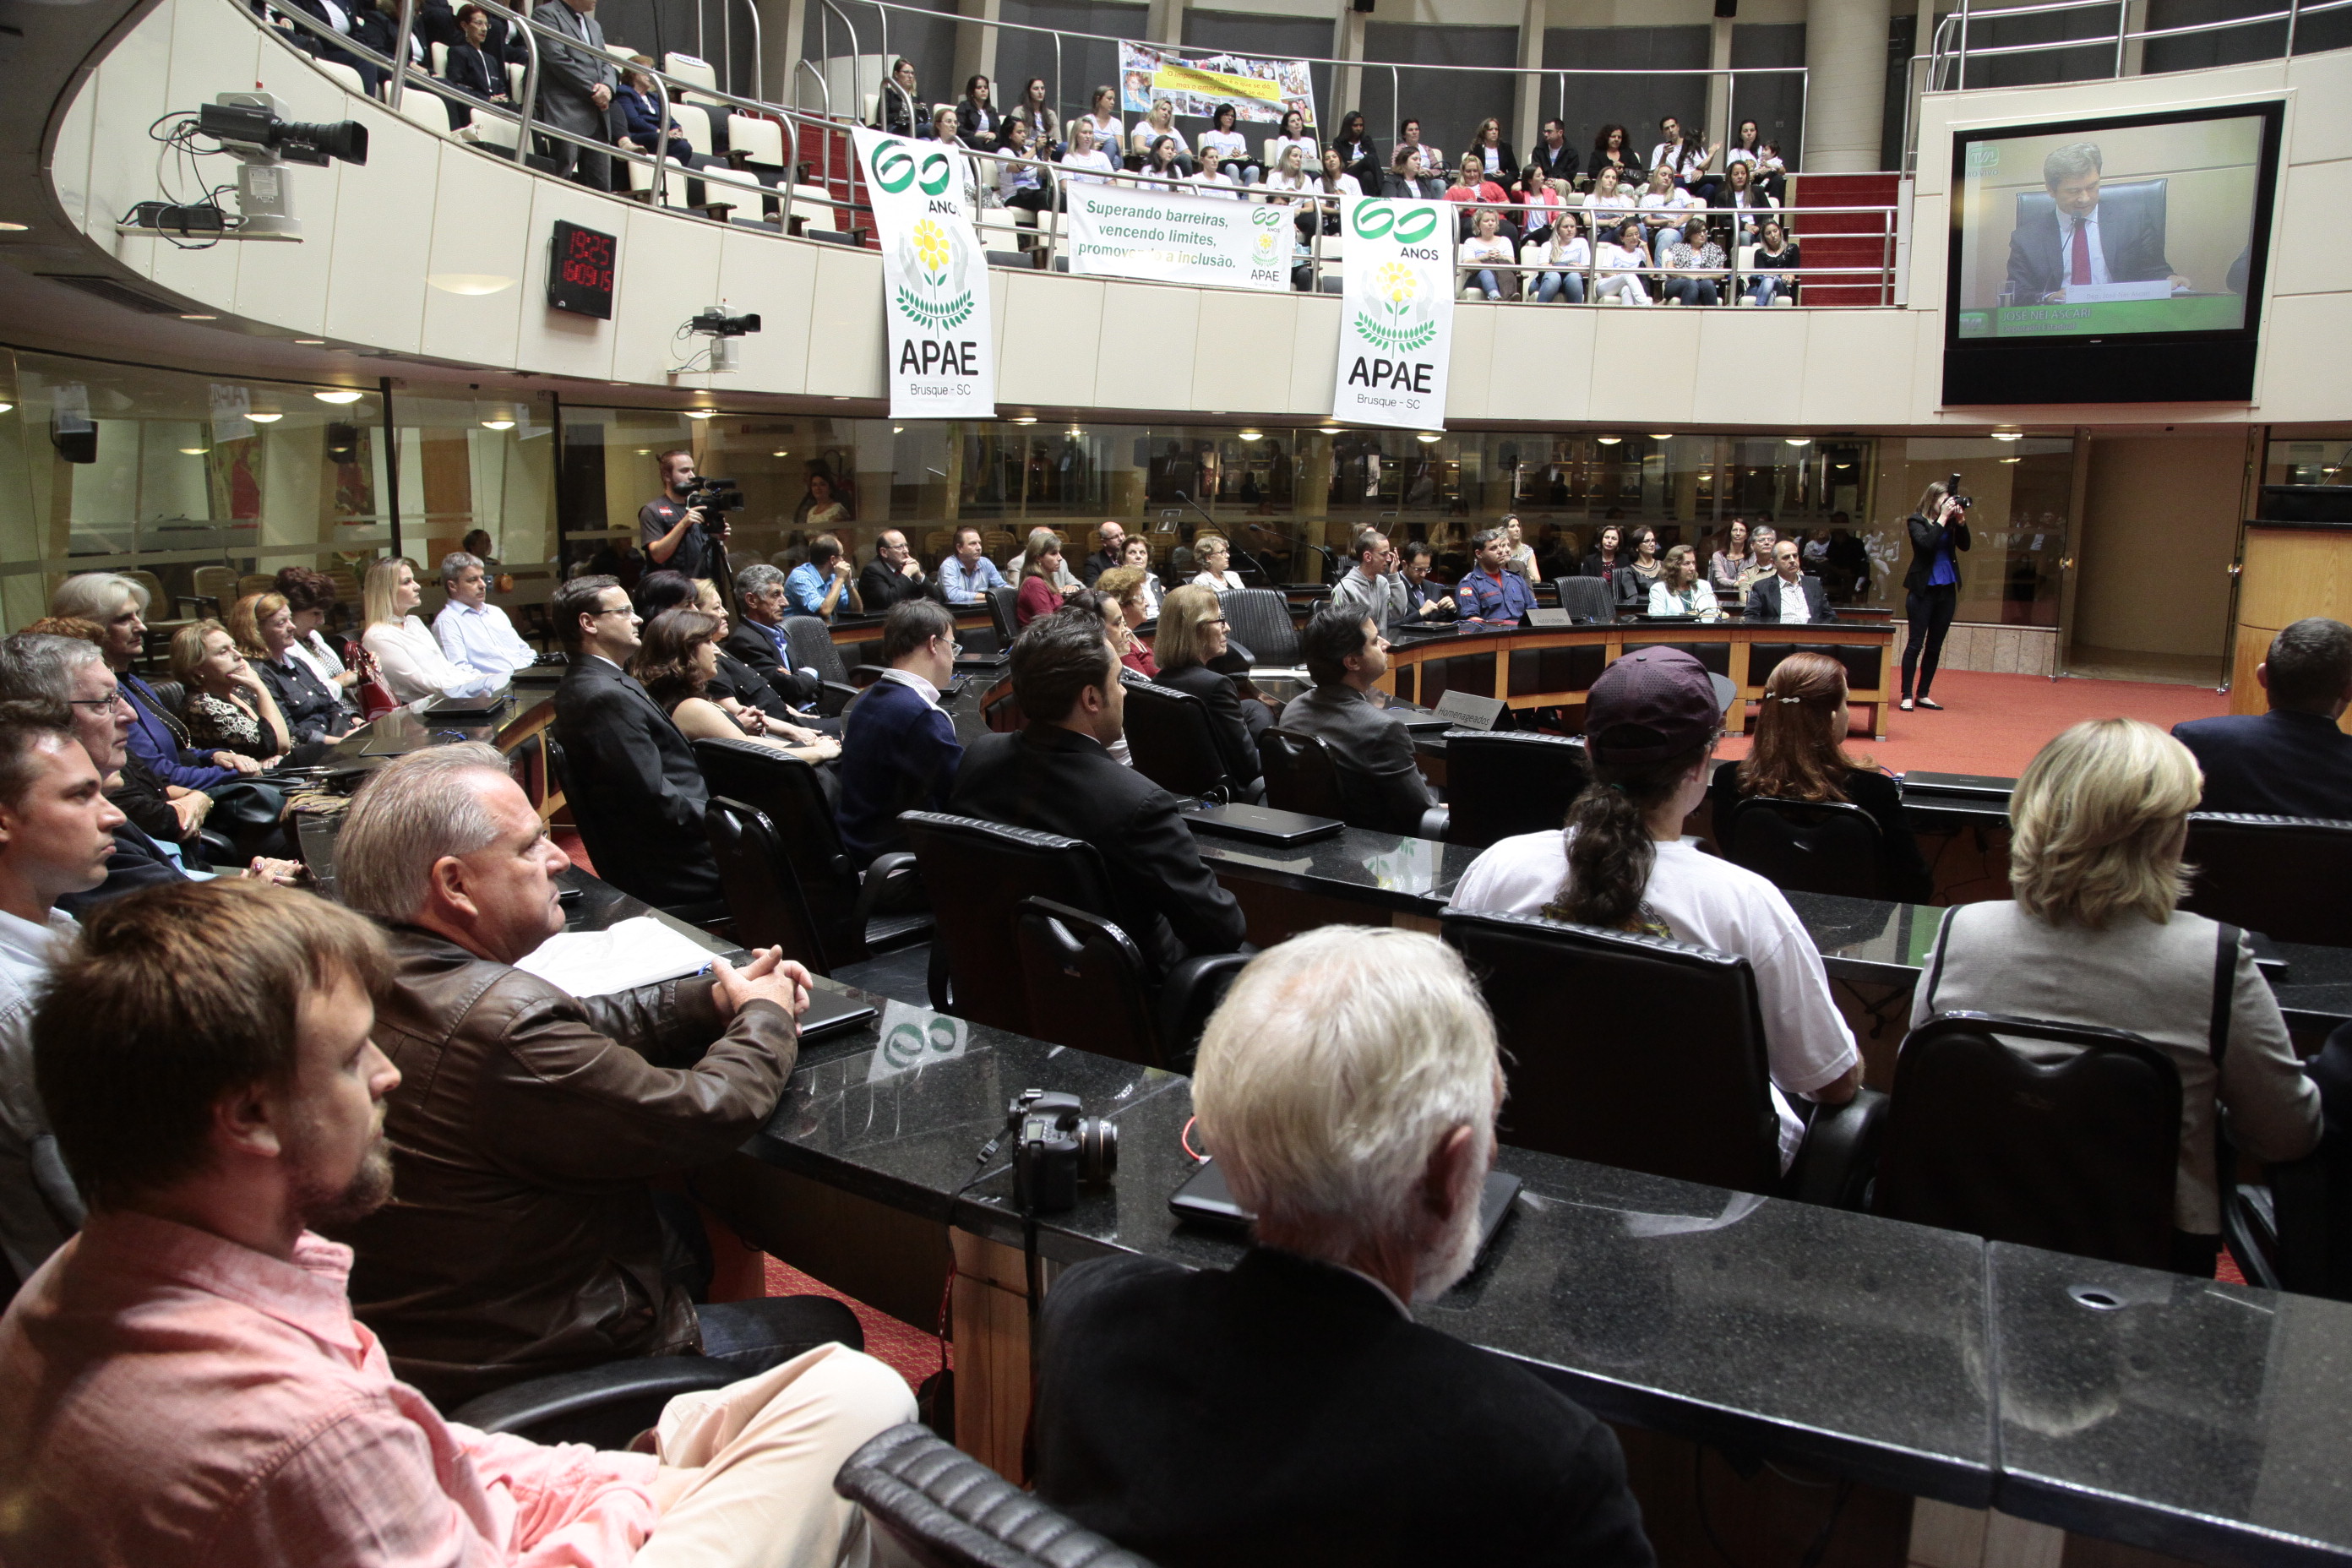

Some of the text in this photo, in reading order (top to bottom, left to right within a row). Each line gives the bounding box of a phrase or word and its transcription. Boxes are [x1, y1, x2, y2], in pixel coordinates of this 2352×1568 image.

[1175, 72, 1214, 81] importante
[871, 139, 950, 196] 60
[1086, 199, 1228, 229] Superando barreiras,
[1252, 206, 1280, 226] 60
[1353, 197, 1437, 244] 60
[1099, 224, 1217, 248] vencendo limites,
[569, 231, 611, 266] 19:25
[1401, 247, 1439, 261] ANOS
[1166, 253, 1173, 262] a
[1178, 250, 1236, 268] inclusão.
[1251, 269, 1279, 282] APAE
[2030, 309, 2048, 320] NEI
[2050, 308, 2091, 320] ASCARI
[2002, 322, 2076, 333] Deputado Estadual
[900, 339, 979, 376] APAE
[1348, 356, 1434, 394] APAE
[910, 383, 948, 397] Brusque
[956, 384, 971, 396] SC
[1357, 393, 1397, 409] Brusque
[1406, 398, 1421, 410] SC
[1438, 706, 1490, 726] Homenageados
